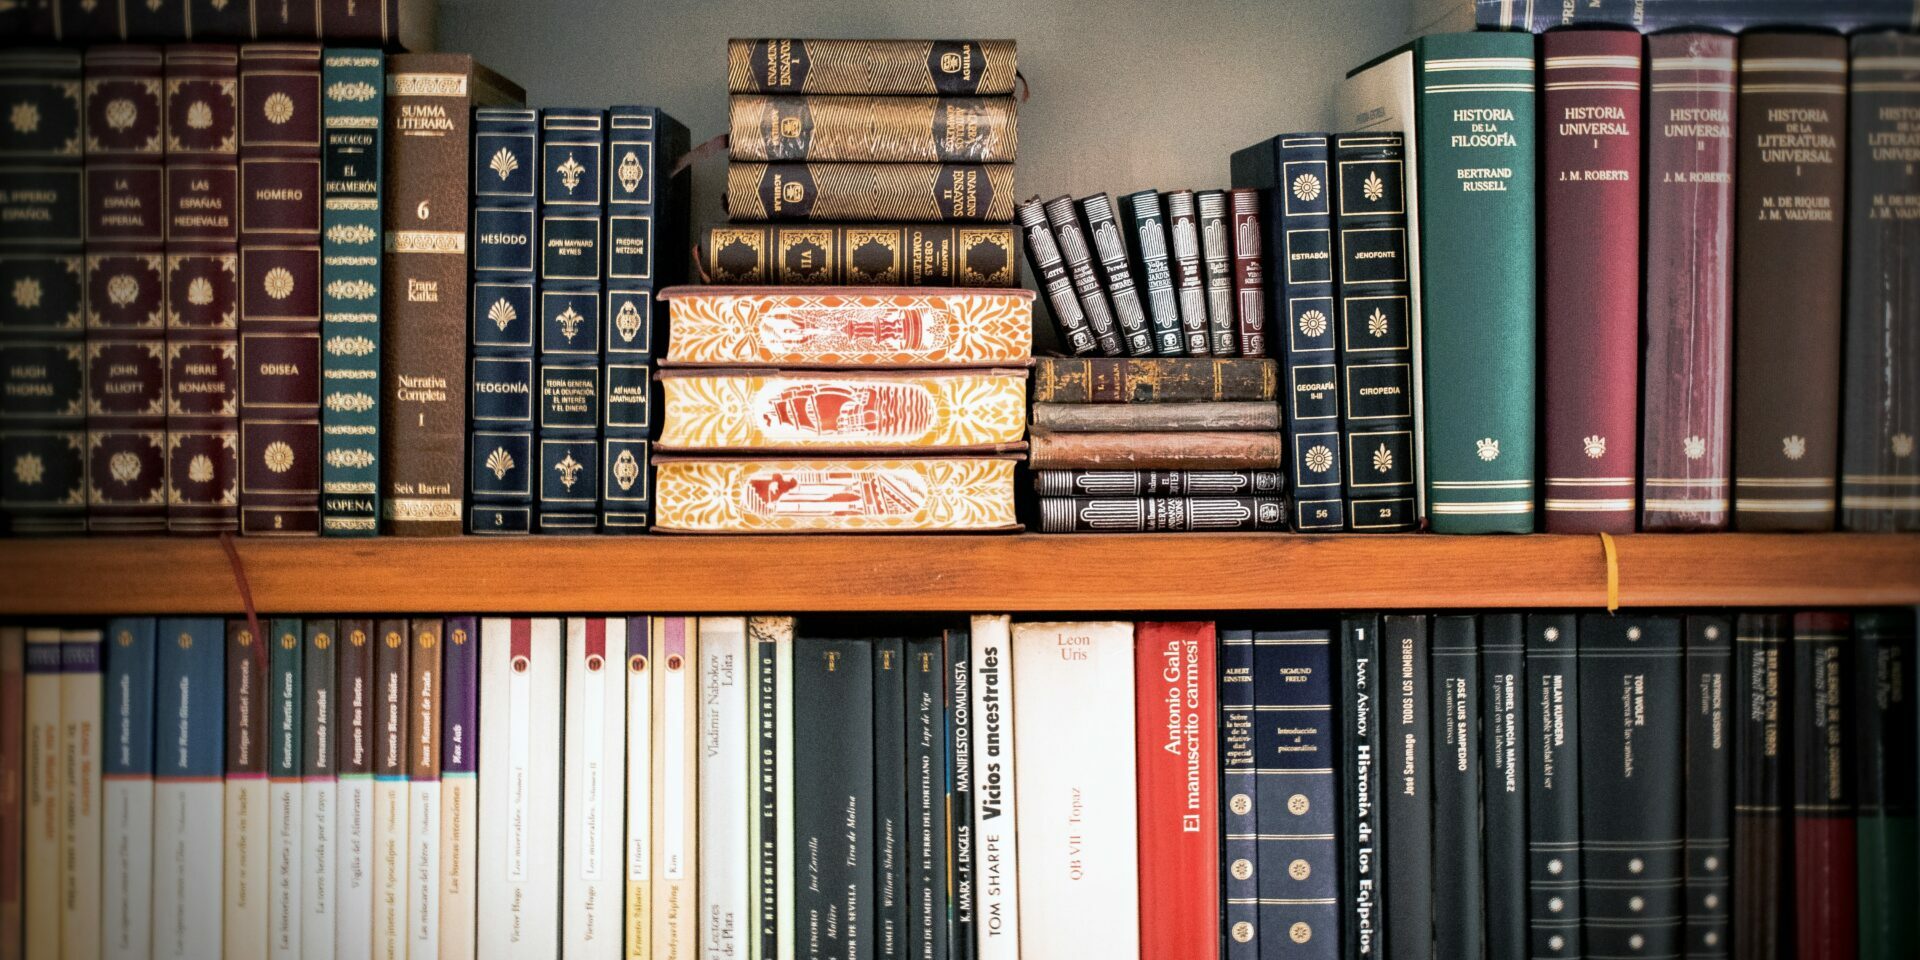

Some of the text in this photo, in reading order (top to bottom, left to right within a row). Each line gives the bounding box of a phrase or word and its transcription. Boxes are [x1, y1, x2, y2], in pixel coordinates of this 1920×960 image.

[768, 40, 777, 86] UNAMUNO
[780, 40, 791, 86] ENSAYOS
[963, 45, 971, 81] AGUILAR
[402, 105, 445, 118] SUMMA
[1453, 109, 1514, 123] HISTORIA
[1565, 107, 1626, 120] HISTORIA
[1670, 108, 1729, 122] HISTORIA
[1768, 109, 1829, 123] HISTORIA
[397, 118, 454, 131] LITERARIA
[1472, 124, 1498, 133] DE LA
[1559, 122, 1630, 136] UNIVERSAL
[1786, 124, 1812, 134] DE LA
[1451, 131, 1517, 148] FILOSOFÍA
[1757, 133, 1836, 148] LITERATURA
[1761, 149, 1832, 163] UNIVERSAL
[344, 165, 357, 177] EL
[1456, 168, 1512, 180] BERTRAND
[1559, 170, 1630, 182] J. M. ROBERTS
[115, 180, 128, 190] LA
[191, 180, 209, 191] LAS
[326, 179, 377, 193] DECAMERÓN
[1463, 180, 1508, 192] RUSSELL
[256, 189, 303, 200] HOMERO
[774, 174, 782, 212] AGUILAR
[944, 189, 952, 199] II
[953, 170, 964, 217] ENSAYOS
[967, 170, 977, 217] UNAMUNO
[104, 197, 141, 209] ESPAÑA
[180, 197, 222, 209] ESPAÑAS
[1762, 196, 1831, 209] M. DE RIQUER
[418, 201, 429, 220] 6
[1758, 208, 1833, 221] J. M. VALVERDE
[102, 216, 144, 226] IMPERIAL
[175, 216, 229, 227] MEDIEVALES
[481, 233, 527, 245] HESÍODO
[801, 249, 812, 269] VII
[913, 231, 922, 285] COMPLETAS
[924, 240, 934, 276] OBRAS
[1291, 251, 1329, 260] ESTRABÓN
[1354, 250, 1396, 260] JENOFONTE
[408, 278, 438, 291] Franz
[408, 290, 438, 302] Kafka
[11, 367, 46, 378] HUGH
[110, 365, 138, 376] JOHN
[186, 364, 217, 375] PIERRE
[260, 364, 299, 376] ODISEA
[105, 382, 144, 394] ELLIOTT
[179, 382, 226, 393] BONASSIE
[398, 375, 447, 389] Narrativa
[476, 381, 529, 394] TEOGONÍA
[1297, 381, 1335, 392] GEOGRAFÍA
[6, 384, 53, 397] THOMAS
[398, 388, 446, 403] Completa
[1359, 386, 1401, 396] CIROPEDIA
[394, 483, 450, 495] Seix Barral
[327, 500, 374, 513] SOPENA
[1379, 508, 1392, 518] 23
[495, 513, 503, 526] 3
[1315, 509, 1329, 519] 56
[1057, 633, 1090, 646] Leon
[1061, 648, 1088, 661] Uris
[720, 653, 734, 687] Lolita
[1225, 667, 1250, 675] ALBERT
[1279, 667, 1313, 675] SIGMUND
[1223, 675, 1253, 683] EINSTEIN
[1285, 675, 1308, 683] FREUD
[1401, 638, 1414, 725] TODOS LOS NOMBRES
[763, 657, 774, 739] AMERICANO
[1163, 640, 1181, 756] Antonio Gala
[1634, 674, 1645, 727] TOM WOLFE
[707, 653, 720, 758] Vladimir Nabokov
[1553, 674, 1564, 747] MILAN KUNDERA
[421, 670, 432, 767] Juan Manuel de Prada
[1456, 677, 1467, 772] JOSÉ LUIS SAMPEDRO
[317, 689, 327, 768] Fernando Arrabal
[956, 660, 969, 793] MANIFIESTO COMUNISTA
[979, 645, 1002, 821] Vicios ancestrales
[1277, 727, 1318, 735] Introducción
[1182, 640, 1201, 833] El manuscrito carmesí
[1505, 674, 1516, 793] GABRIEL GARCÍA MÁRQUEZ
[452, 724, 462, 764] Max Aub
[763, 748, 774, 793] AMIGO
[1403, 733, 1416, 796] José Saramago
[763, 803, 774, 818] EL
[1069, 787, 1084, 881] QB VII Topaz
[1357, 821, 1372, 843] de
[668, 854, 679, 874] Kim
[1357, 847, 1372, 874] los
[958, 825, 971, 922] K. MARX F. ENGELS
[986, 834, 1001, 938] TOM SHARPE
[708, 903, 720, 952] Lectores
[721, 911, 734, 957] de Plata
